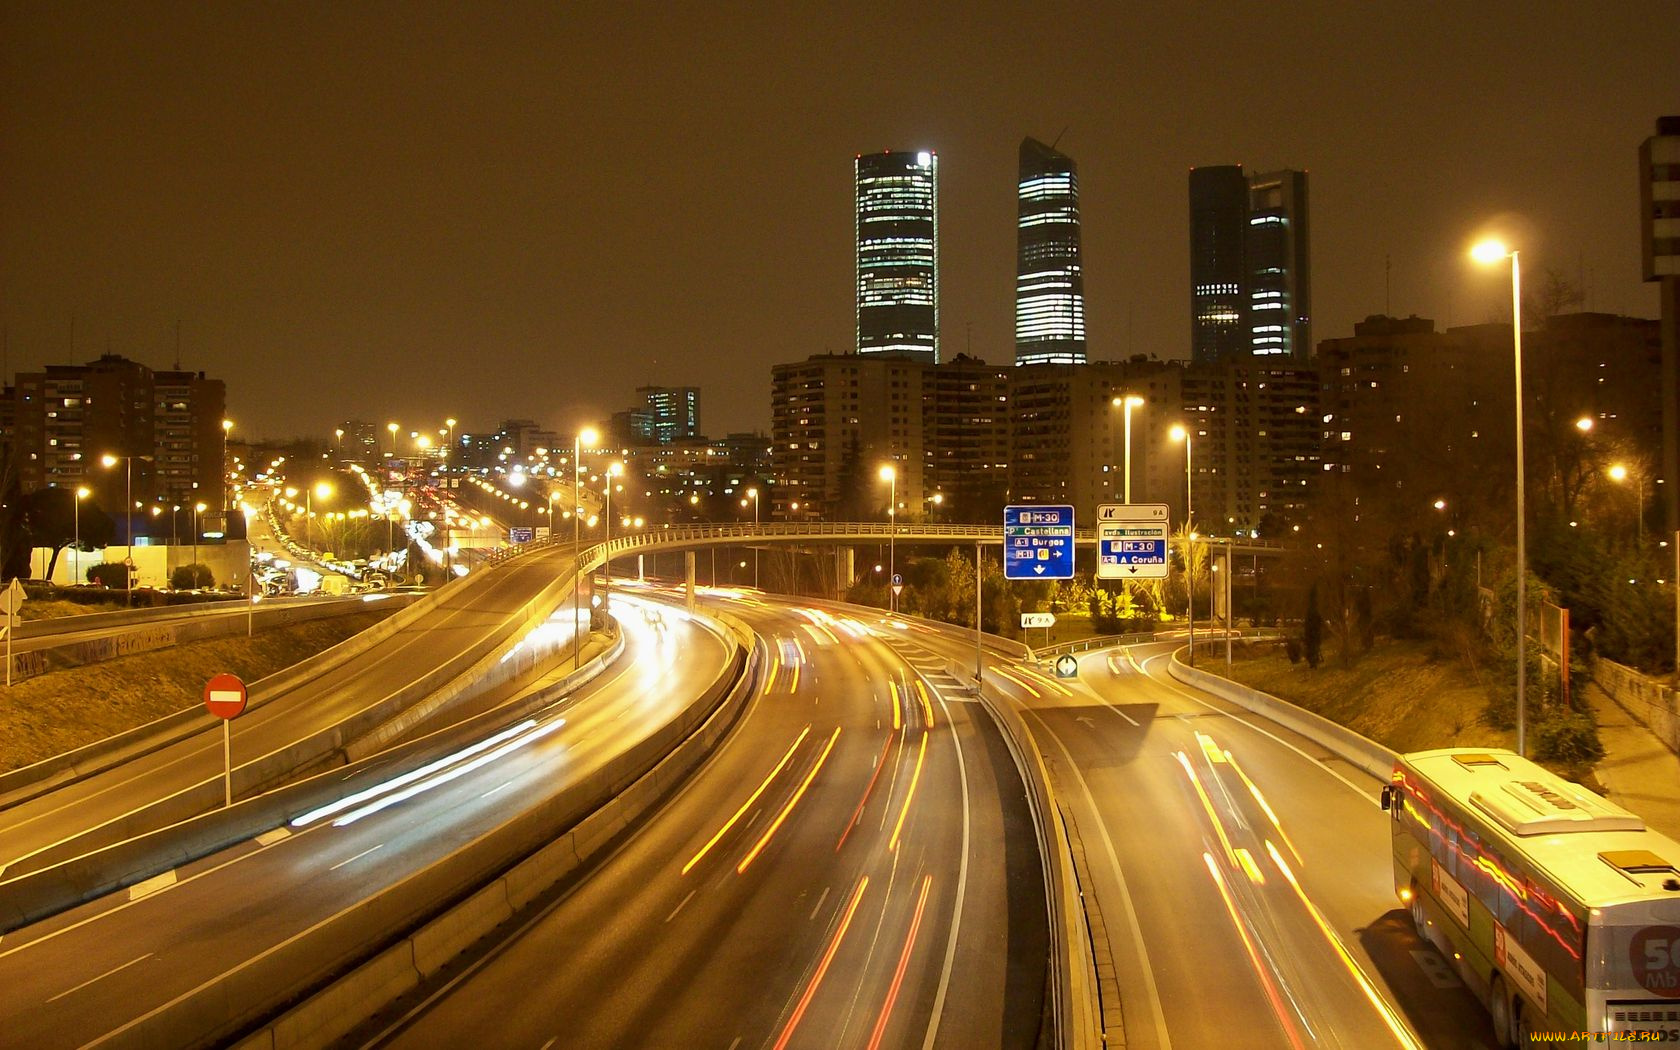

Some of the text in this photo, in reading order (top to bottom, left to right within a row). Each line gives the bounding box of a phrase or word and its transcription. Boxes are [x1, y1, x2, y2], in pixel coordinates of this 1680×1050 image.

[1034, 513, 1058, 522] M-30
[1024, 527, 1069, 535] Castellana
[1032, 538, 1064, 547] Burgos
[1125, 542, 1153, 551] M-30
[1120, 556, 1127, 564] A
[1131, 556, 1163, 564] Coruña
